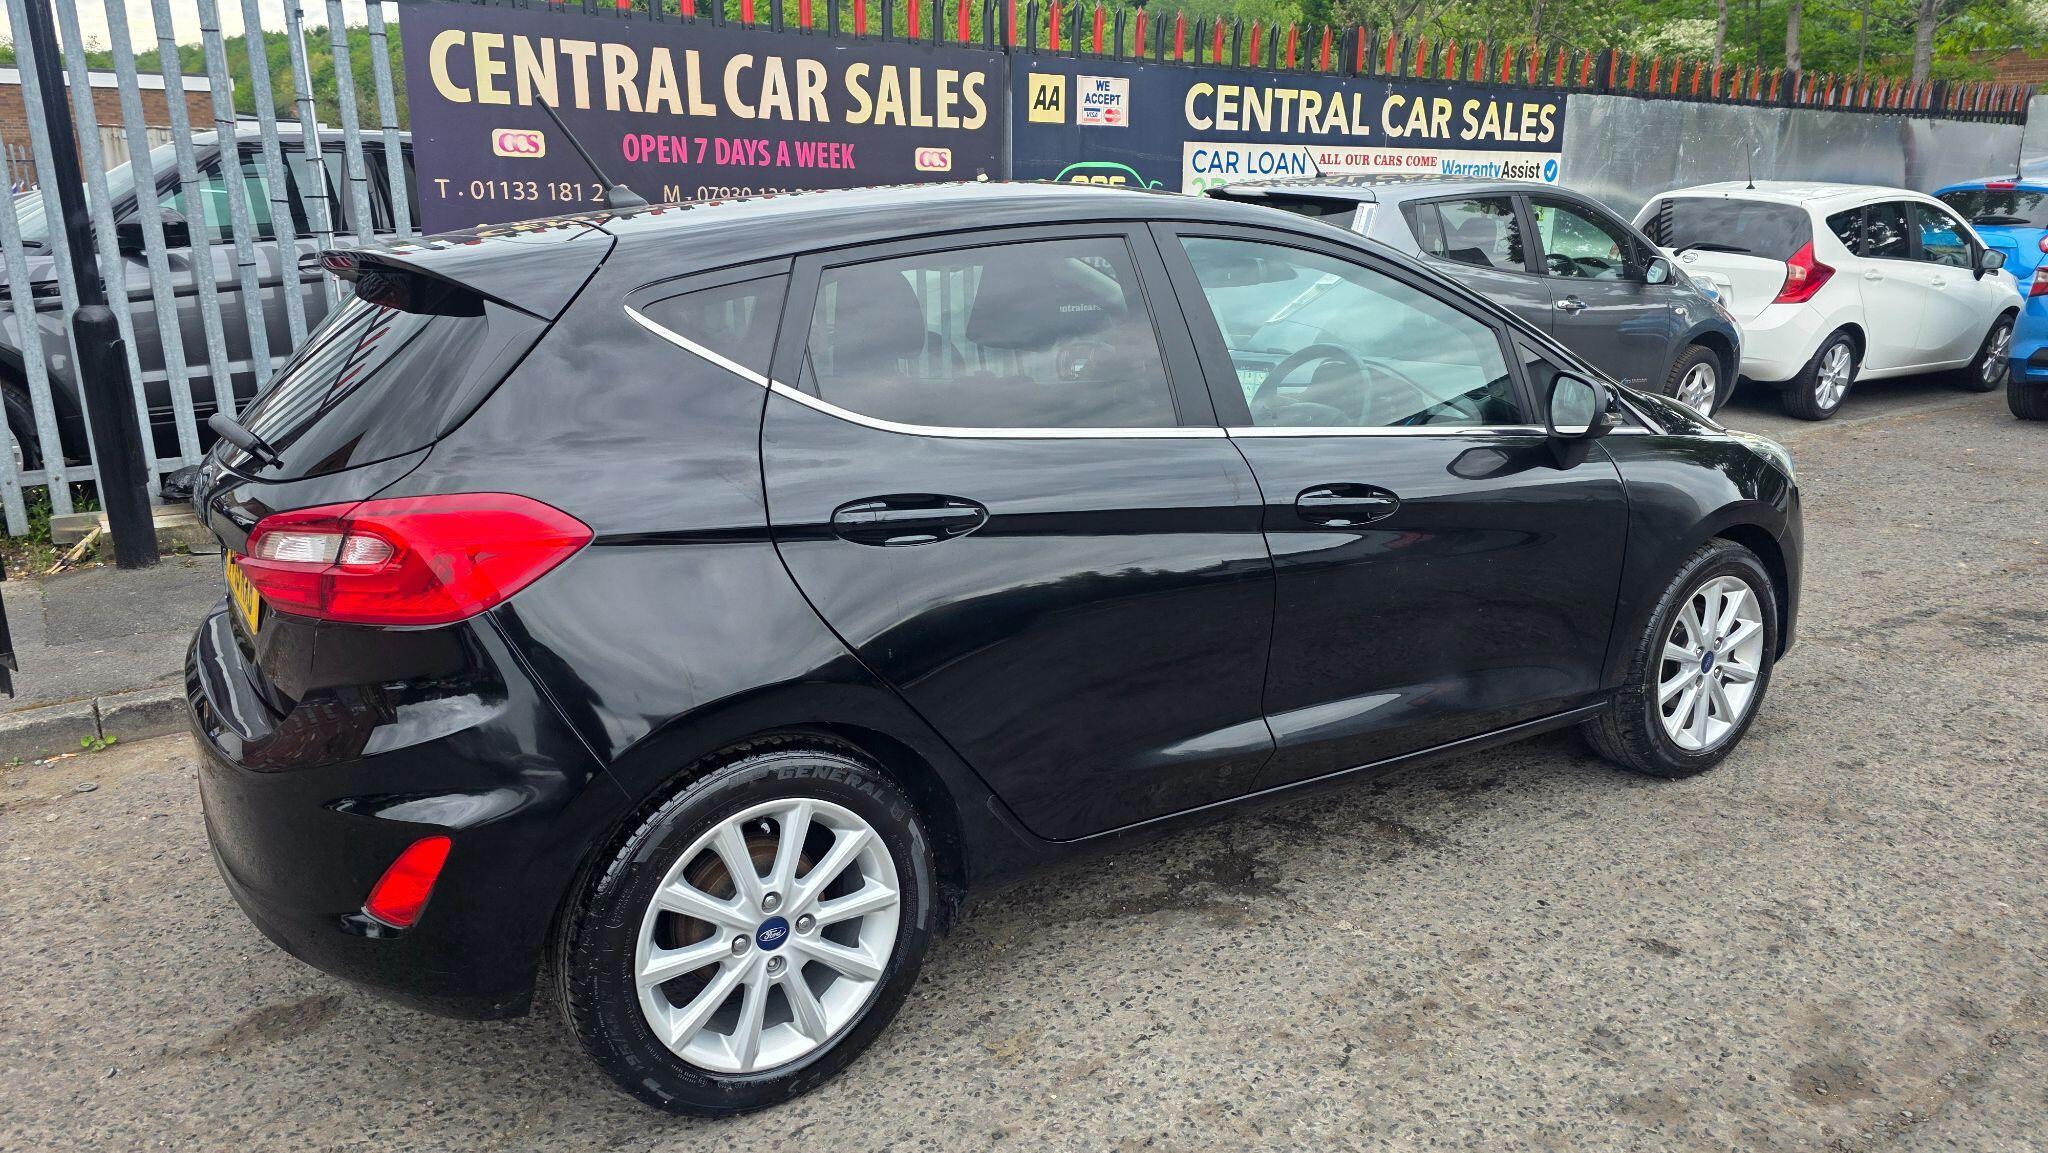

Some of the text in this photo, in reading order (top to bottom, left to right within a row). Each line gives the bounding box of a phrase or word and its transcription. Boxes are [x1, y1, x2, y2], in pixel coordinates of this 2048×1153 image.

[429, 29, 987, 130] CENTRAL CAR SALES
[1095, 80, 1111, 92] WE
[1032, 84, 1060, 112] AA
[1084, 93, 1121, 106] ACCEPT
[1184, 82, 1557, 143] CENTRAL CAR SALES
[498, 132, 540, 154] CCS
[622, 133, 855, 169] OPEN 7 DAYS A WEEK
[920, 150, 948, 168] CCS
[1191, 149, 1307, 175] CAR LOAN
[1318, 153, 1438, 168] ALL OUR CARS COME
[470, 180, 539, 201] 01133
[547, 182, 582, 202] 181
[777, 764, 886, 804] GENERAL
[763, 927, 784, 941] Ford
